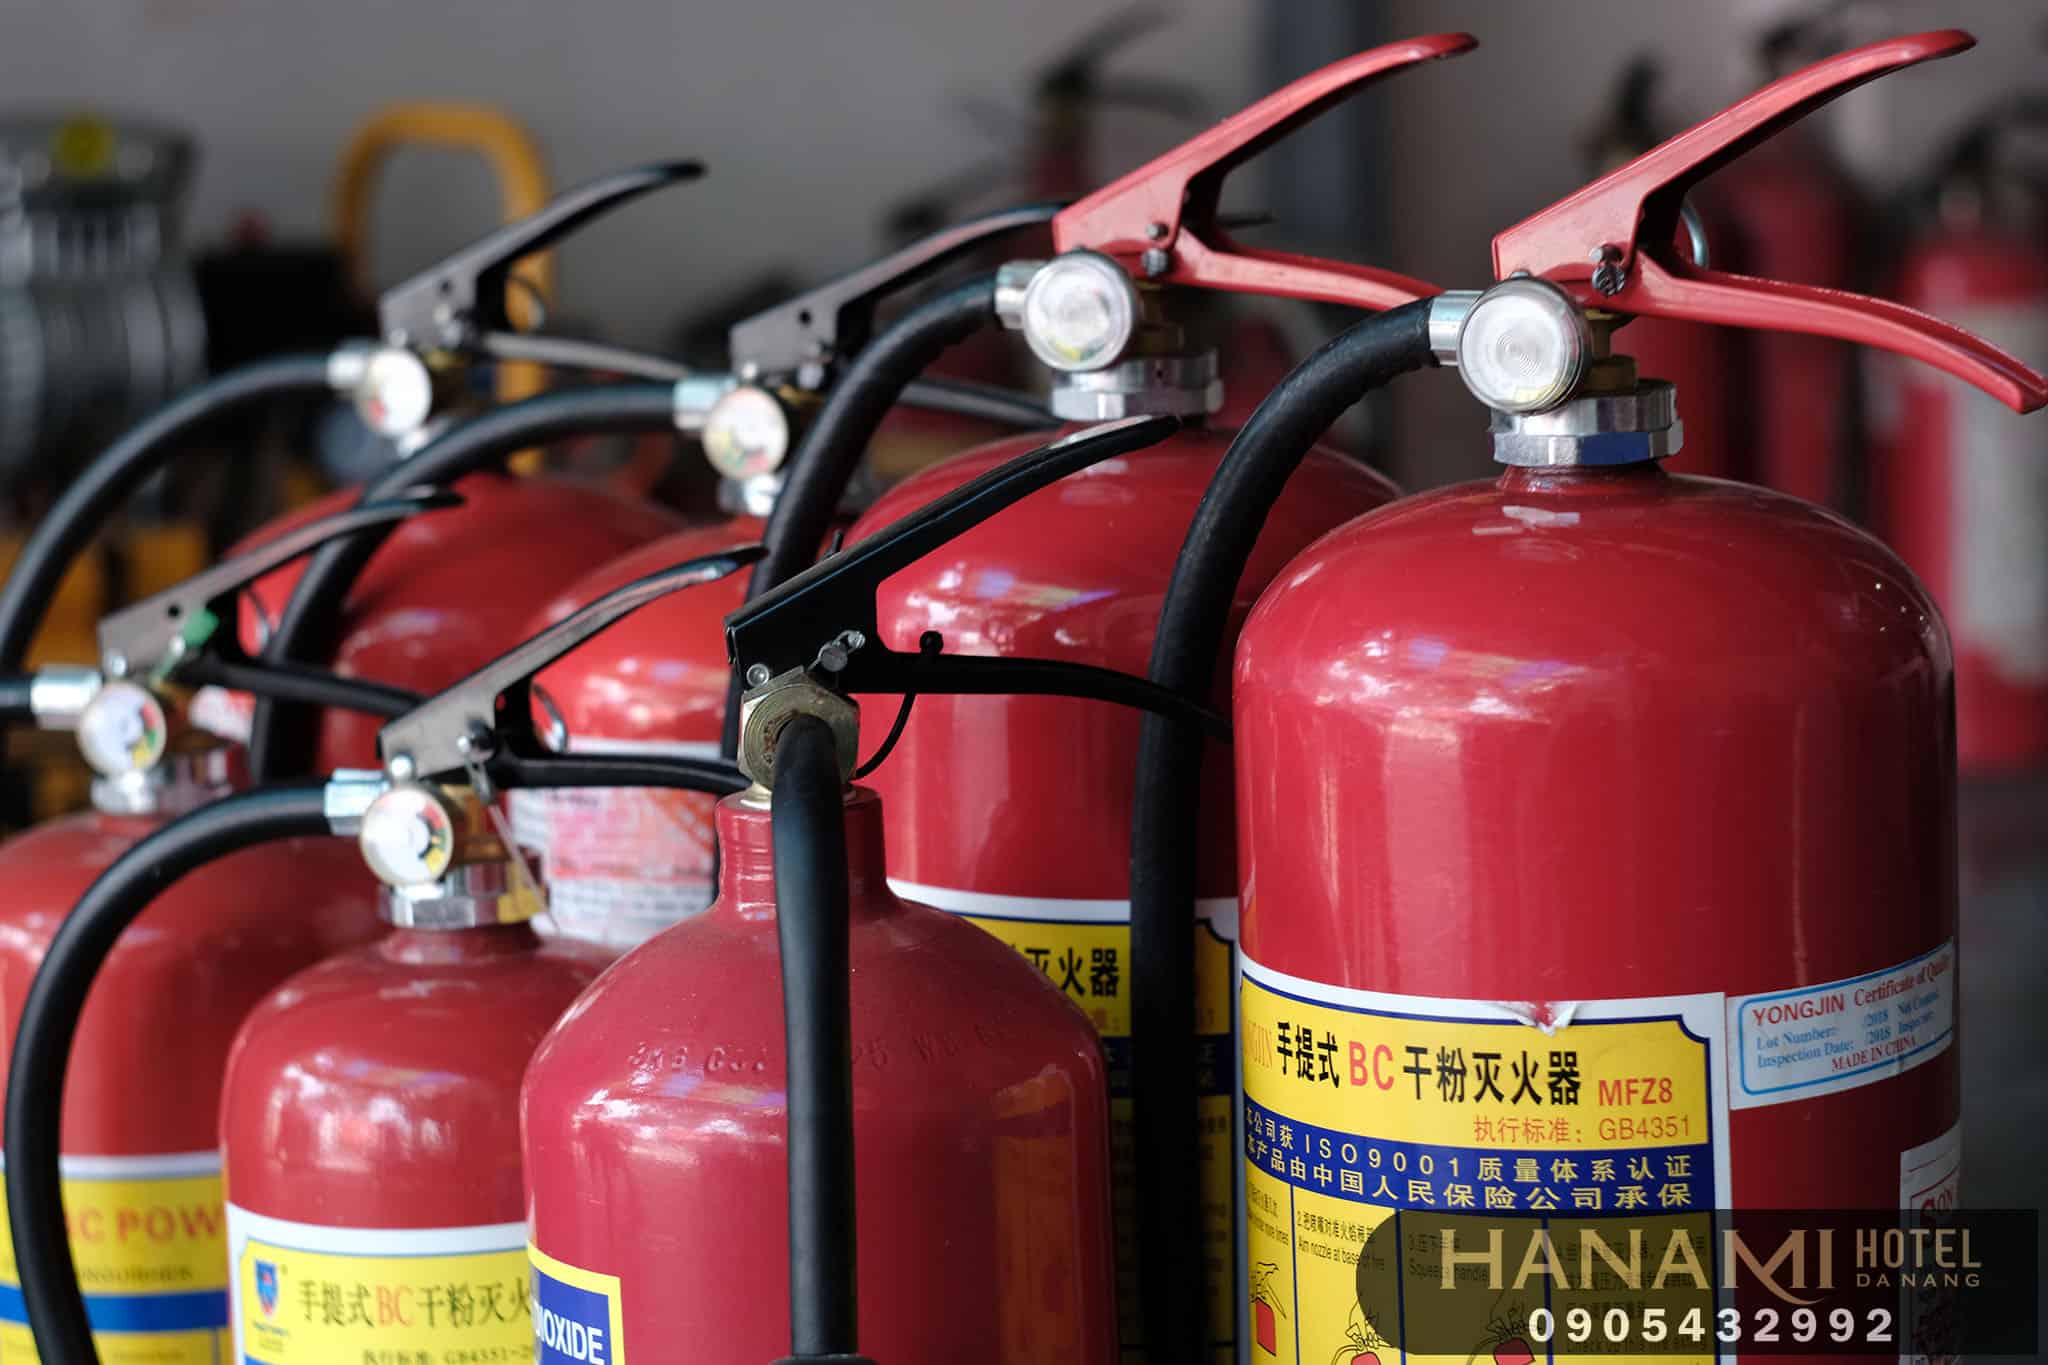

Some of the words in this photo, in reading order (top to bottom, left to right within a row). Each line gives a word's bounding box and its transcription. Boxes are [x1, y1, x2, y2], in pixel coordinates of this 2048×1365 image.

[1752, 993, 1845, 1026] YONGJIN
[1855, 972, 1916, 1006] Certificate
[1756, 1034, 1779, 1050] Lot
[1831, 1047, 1868, 1072] MADE
[1870, 1044, 1885, 1062] IN
[1886, 1034, 1918, 1059] CHINA
[1757, 1046, 1822, 1069] Inspection
[1599, 1077, 1674, 1106] MFZ8
[1599, 1115, 1691, 1141] GB4351
